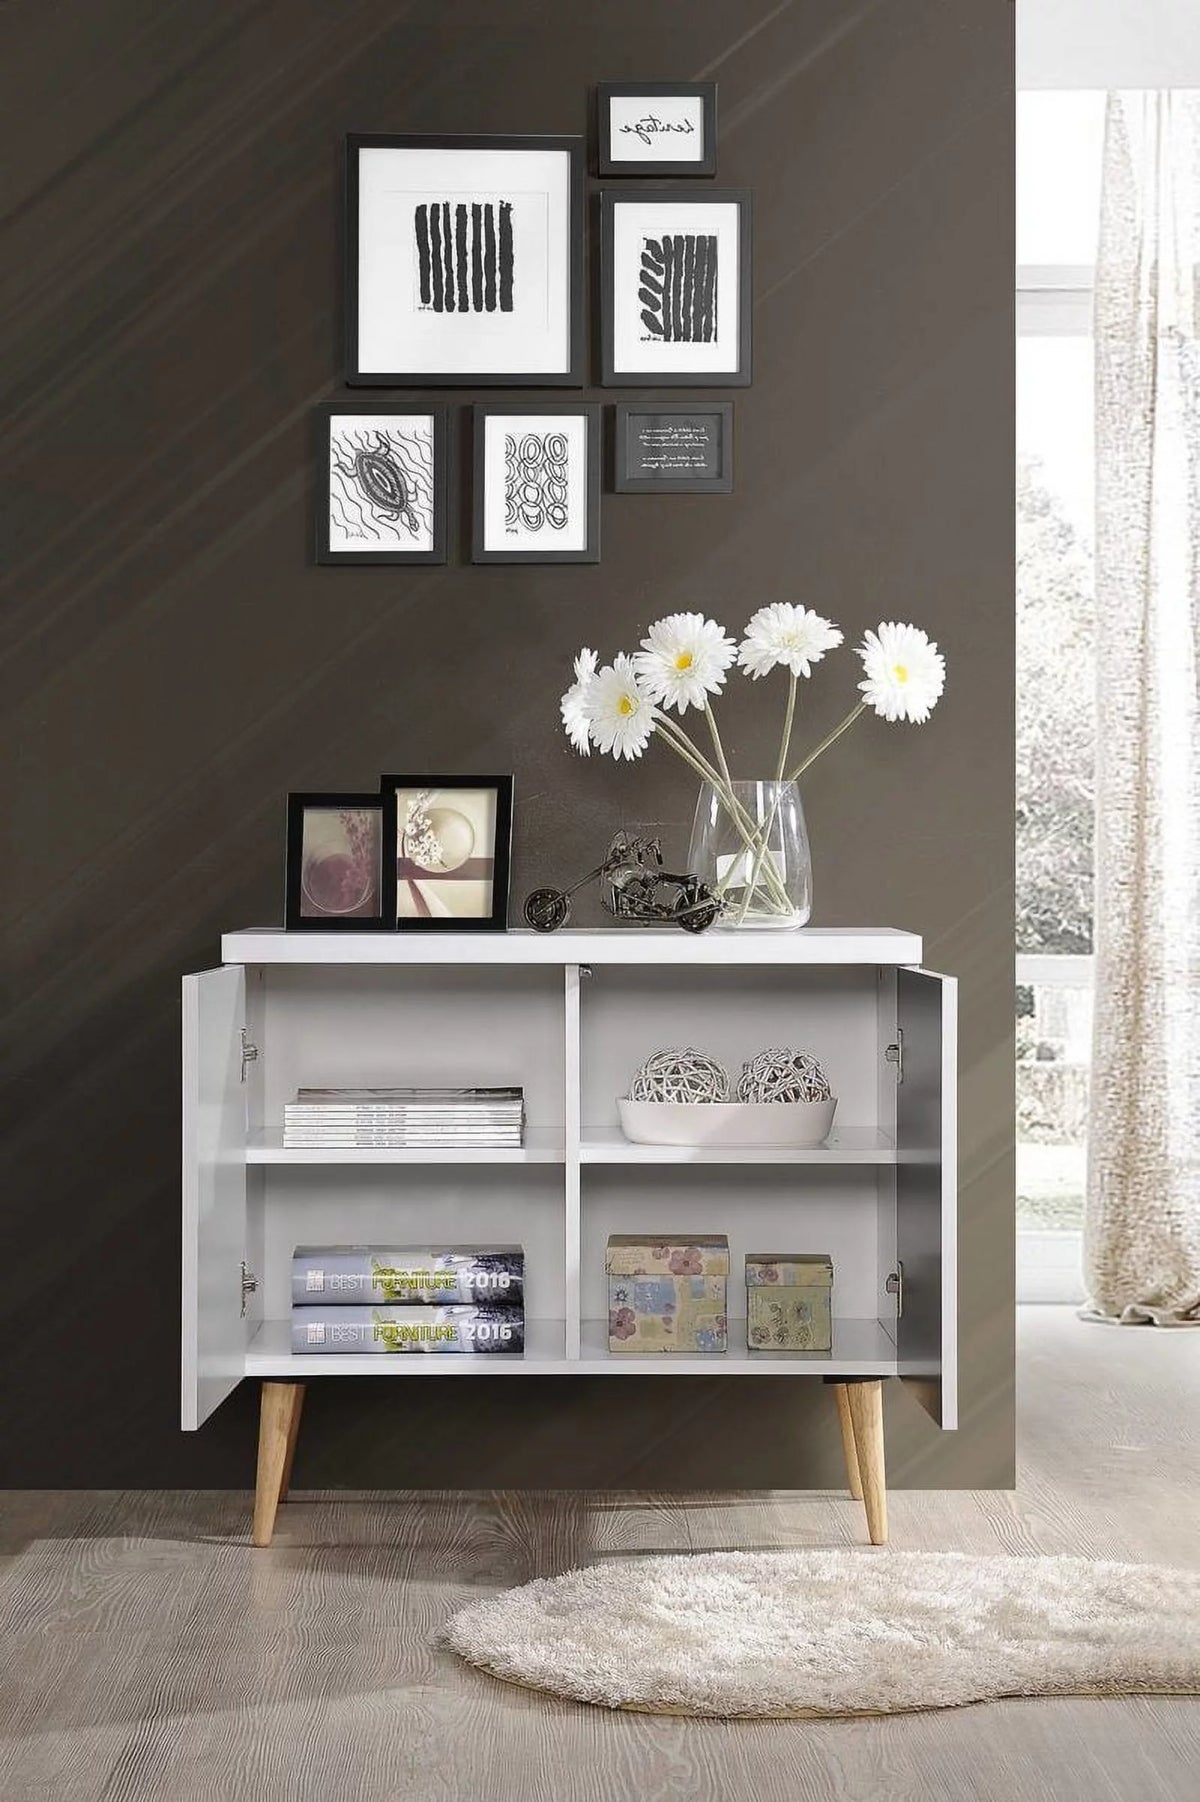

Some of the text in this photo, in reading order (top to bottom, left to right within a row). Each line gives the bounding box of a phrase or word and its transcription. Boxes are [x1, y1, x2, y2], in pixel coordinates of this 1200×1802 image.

[330, 1270, 510, 1289] BEST FURNITURE 2016
[331, 1323, 512, 1342] BEST FURNITURE 2016
